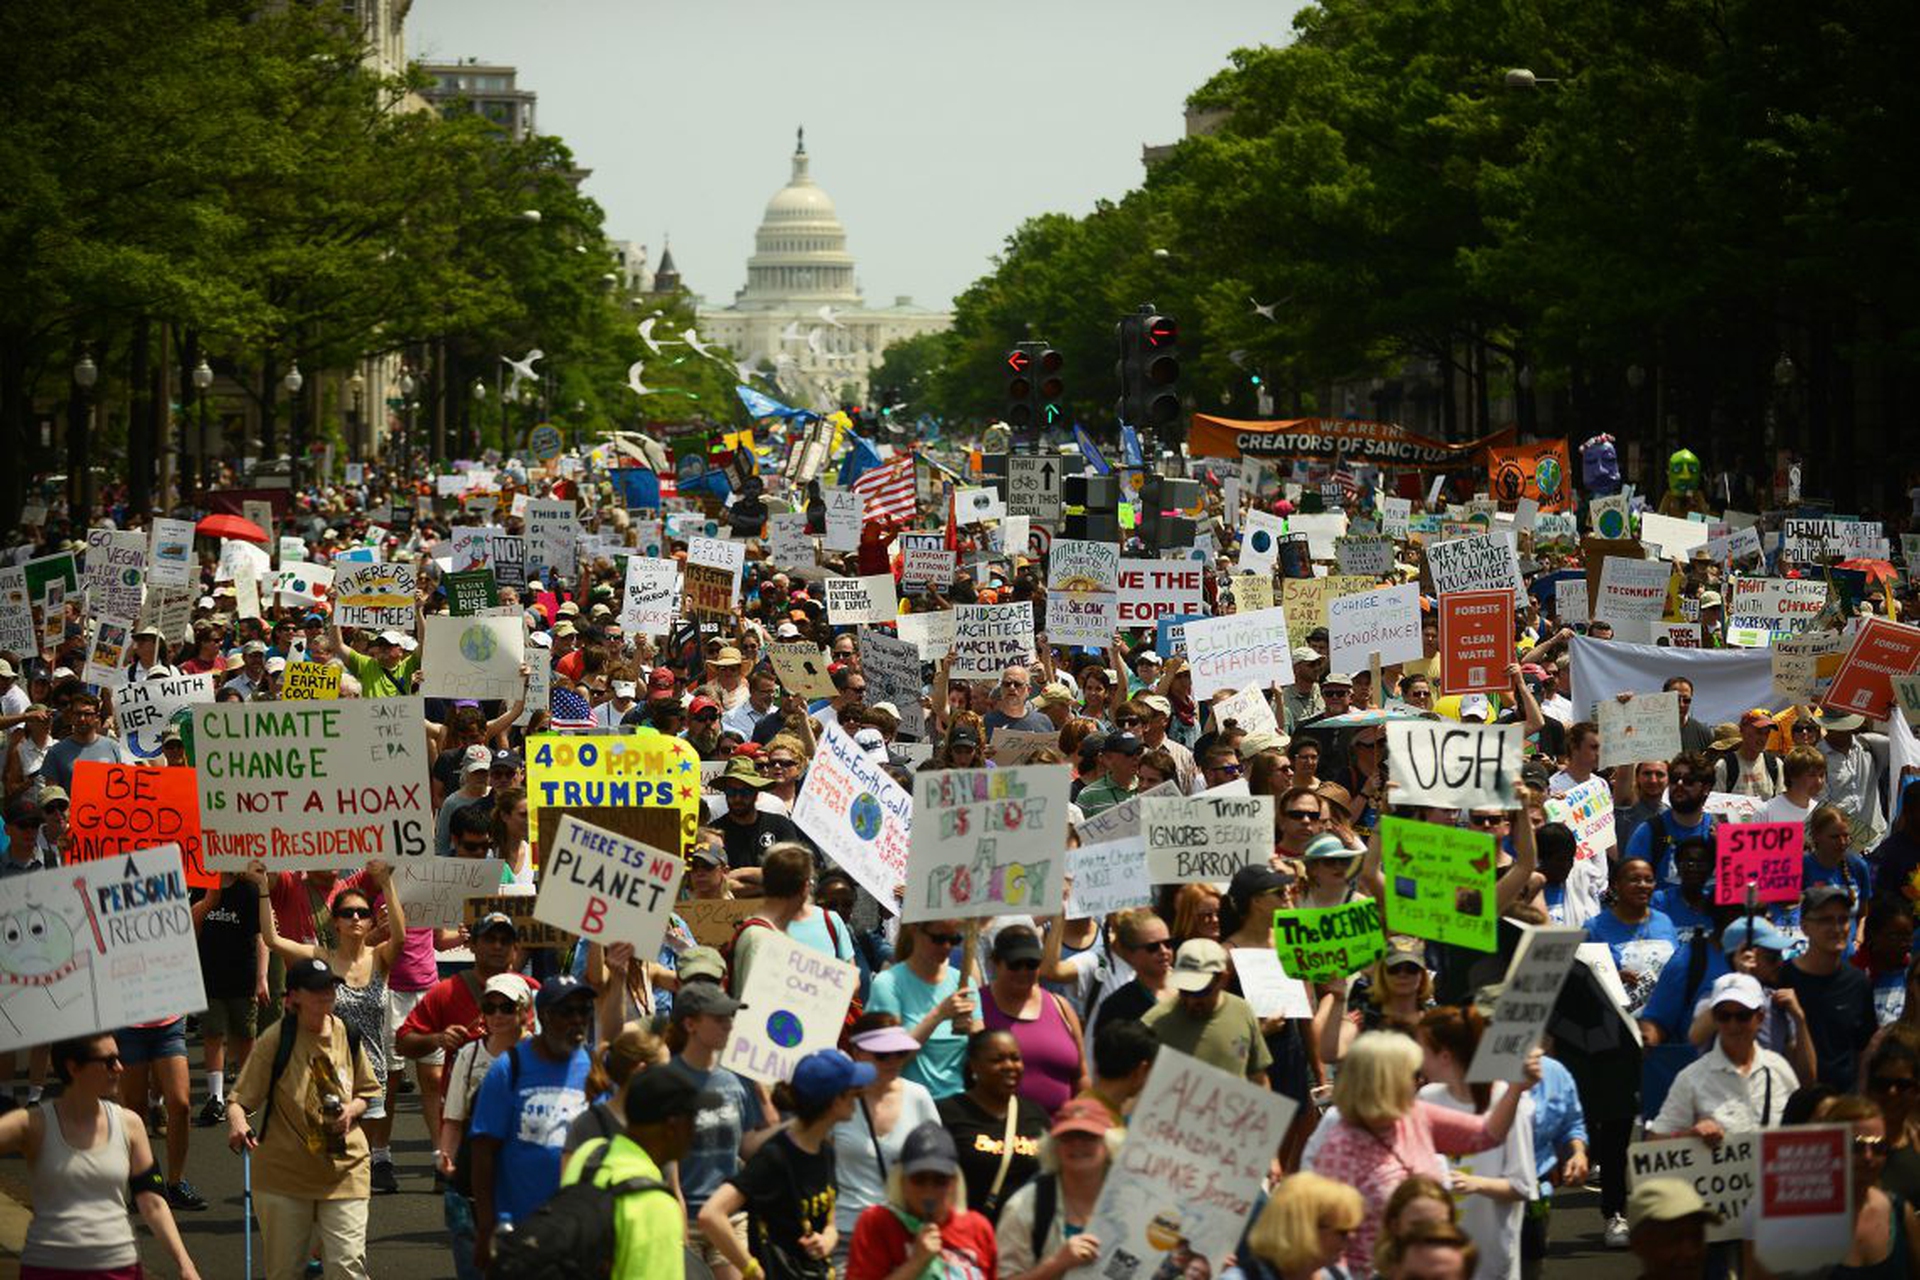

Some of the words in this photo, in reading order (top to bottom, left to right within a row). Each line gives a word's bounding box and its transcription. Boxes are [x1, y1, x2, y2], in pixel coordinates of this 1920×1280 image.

[1319, 421, 1342, 433] WE
[1347, 422, 1377, 436] ARE
[1237, 433, 1334, 450] CREATORS
[1337, 436, 1363, 451] OF
[1011, 459, 1036, 471] THRU
[1010, 494, 1033, 505] OBEY
[1038, 494, 1059, 505] THIS
[1321, 484, 1343, 496] NO!
[531, 510, 557, 520] THIS
[559, 510, 572, 520] IS
[1010, 507, 1042, 516] SIGNAL
[88, 531, 113, 547] GO
[1786, 521, 1840, 539] DENIAL
[494, 537, 524, 563] NO!
[693, 538, 735, 553] COAL
[1429, 541, 1451, 563] GIVE
[1451, 539, 1467, 557] ME
[106, 547, 144, 567] VEGAN
[911, 551, 950, 562] SUPPORT
[1440, 555, 1459, 576] MY
[1461, 545, 1511, 571] CLIMATE
[917, 561, 951, 573] STRONG
[338, 575, 356, 596] I'M
[355, 563, 391, 585] HERE
[391, 564, 416, 596] FOR
[827, 580, 859, 590] RESPECT
[1117, 571, 1145, 589] WE
[1150, 571, 1200, 589] THE
[1436, 574, 1458, 593] YOU
[1457, 569, 1482, 588] CAN
[1484, 562, 1509, 582] KEEP
[457, 590, 488, 600] BUILD
[629, 582, 658, 597] BLACK
[633, 589, 672, 606] MIRROR
[700, 584, 730, 610] HOT
[829, 590, 868, 601] EXISTENCE
[1285, 582, 1321, 600] SAV
[1607, 585, 1619, 594] TO
[1619, 587, 1665, 598] COMMENT?
[1736, 580, 1767, 594] FIGHT
[1784, 581, 1828, 596] CHANGE
[458, 598, 488, 611] RISE
[844, 600, 872, 611] EXPECT
[955, 605, 1031, 622] LANDSCAPE
[1068, 600, 1085, 614] SHE
[1084, 601, 1105, 615] CAN
[1289, 608, 1321, 621] EART
[1331, 596, 1380, 616] CHANGE
[1455, 603, 1500, 616] FORESTS
[1736, 599, 1763, 612] WITH
[1777, 599, 1822, 613] CHANGE
[341, 605, 369, 625] THE
[373, 605, 415, 627] TREES
[627, 607, 669, 626] SUCKS
[955, 620, 1034, 638] ARCHITECTS
[1193, 625, 1284, 652] CLIMATE
[1668, 628, 1694, 639] TOXIC
[955, 639, 997, 654] MARCH
[999, 639, 1026, 653] FOR
[1460, 634, 1495, 645] CLEAN
[953, 656, 976, 672] THE
[976, 654, 1031, 673] CLIMATE
[1198, 650, 1284, 678] CHANGE
[1458, 650, 1496, 662] WATER
[289, 664, 328, 677] MAKE
[118, 685, 149, 705] I'M
[161, 677, 204, 697] WITH
[290, 674, 336, 689] EARTH
[285, 686, 320, 700] COOL
[121, 705, 163, 729] HER
[203, 709, 342, 740] CLIMATE
[370, 704, 409, 719] SAVE
[205, 747, 329, 780] CHANGE
[375, 723, 404, 738] THE
[369, 744, 412, 762] EPA
[534, 743, 598, 768] 400
[1407, 728, 1506, 791] UGH
[825, 728, 852, 769] Make
[851, 754, 881, 796] Earth
[105, 767, 161, 801] BE
[540, 781, 674, 807] TRUMPS
[925, 769, 1027, 809] DENIAL
[205, 790, 227, 810] IS
[236, 791, 289, 813] NOT
[302, 789, 324, 813] A
[336, 782, 421, 815] HOAX
[76, 803, 182, 835] GOOD
[940, 806, 970, 841] IS
[984, 797, 1048, 833] NOT
[1150, 799, 1199, 821] WHAT
[1208, 798, 1260, 818] Trump
[1079, 813, 1120, 839] THE
[1149, 825, 1209, 846] IGNORES
[1214, 825, 1273, 845] BECOMES
[270, 822, 385, 858] PRESIDENCY
[392, 818, 427, 856] IS
[762, 833, 773, 847] 3
[1730, 827, 1794, 853] STOP
[570, 824, 618, 858] THERE
[620, 845, 646, 869] IS
[648, 857, 674, 883] NO
[1176, 848, 1250, 877] BARRON
[123, 852, 139, 879] A
[404, 861, 484, 889] KILLING
[1760, 857, 1791, 874] BIG
[552, 848, 666, 913] PLANET
[926, 859, 1051, 909] POLICY
[97, 868, 187, 915] PERSONAL
[432, 885, 453, 904] US
[205, 907, 240, 925] esist.
[580, 896, 608, 935] B
[1277, 916, 1320, 945] The
[1319, 902, 1381, 942] OCEANS
[108, 906, 192, 948] RECORD
[1293, 946, 1348, 971] Rising
[787, 949, 847, 989] FUTURE
[1163, 1069, 1272, 1148] ALASKA
[1141, 1113, 1238, 1179] GRANDMA
[1777, 1143, 1833, 1160] MAKE
[1124, 1142, 1200, 1191] CLIMATE
[1633, 1148, 1694, 1176] MAKE
